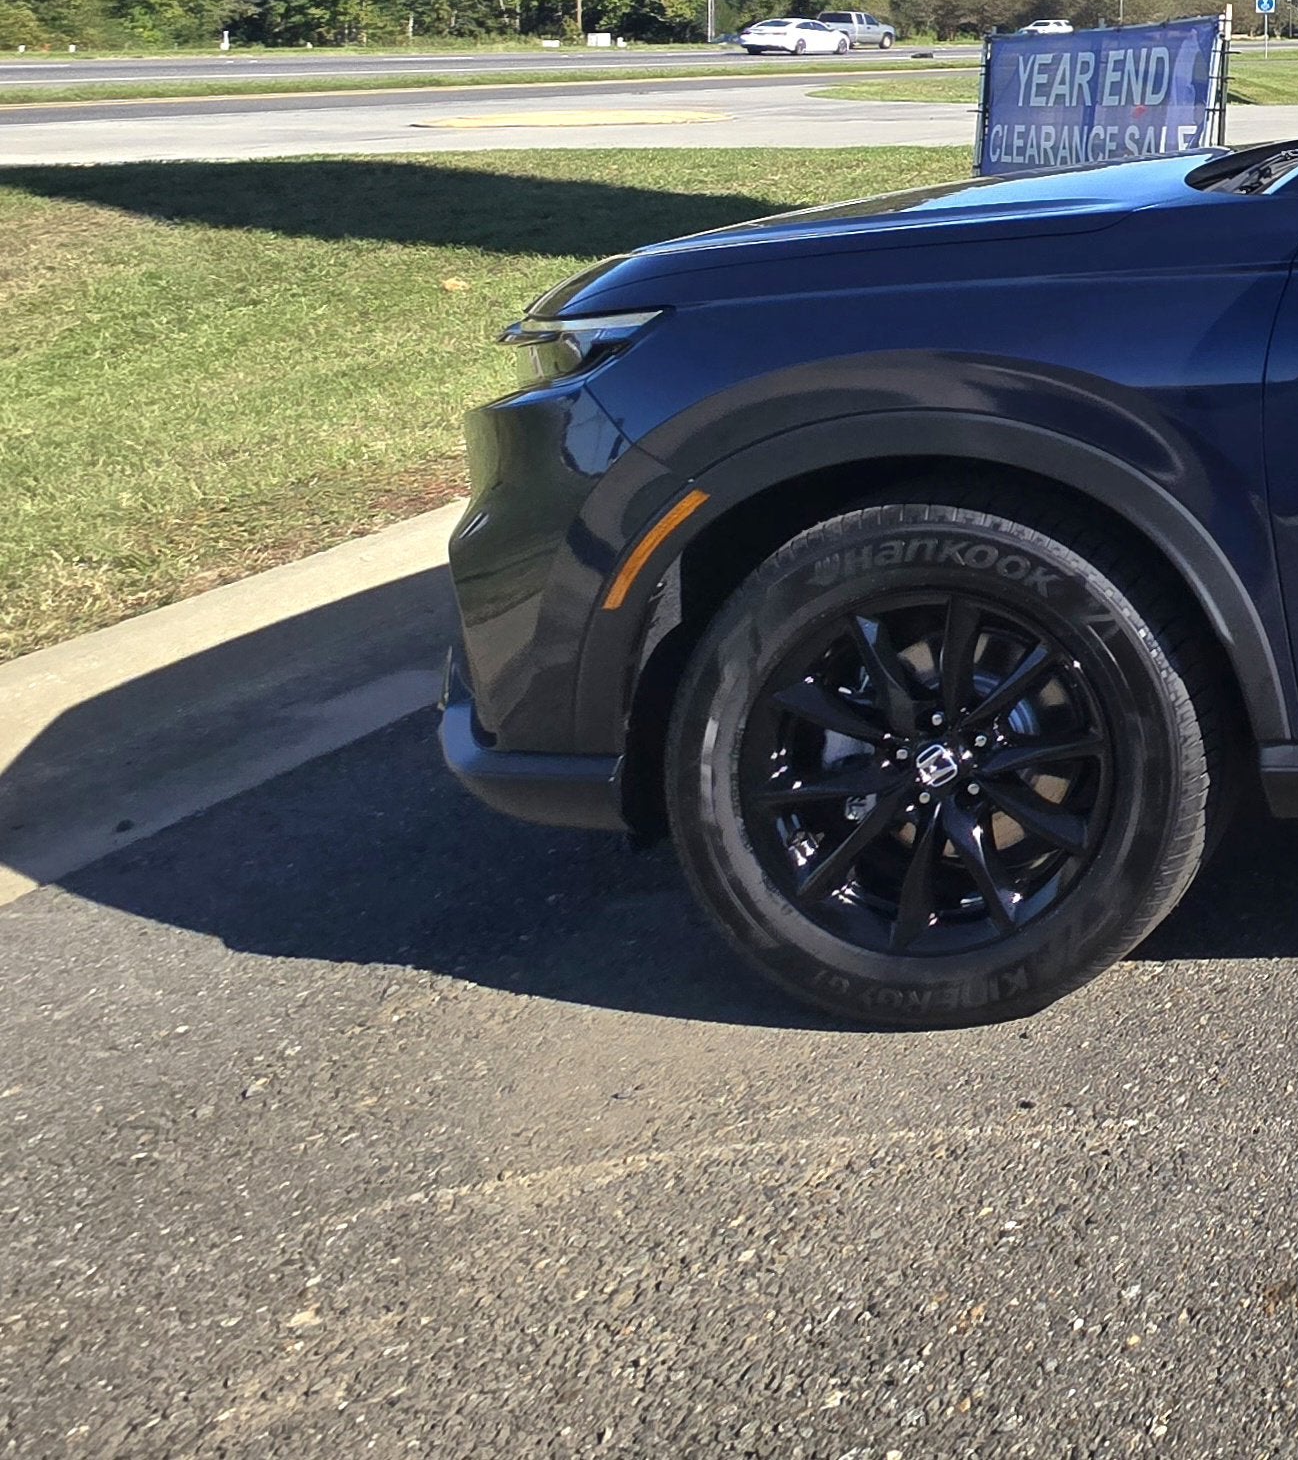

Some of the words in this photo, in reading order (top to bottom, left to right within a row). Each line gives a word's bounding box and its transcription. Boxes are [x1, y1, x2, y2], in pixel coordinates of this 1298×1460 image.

[1017, 50, 1096, 108] YEAR
[1101, 46, 1170, 107] END
[989, 124, 1119, 166] CLEARANCE
